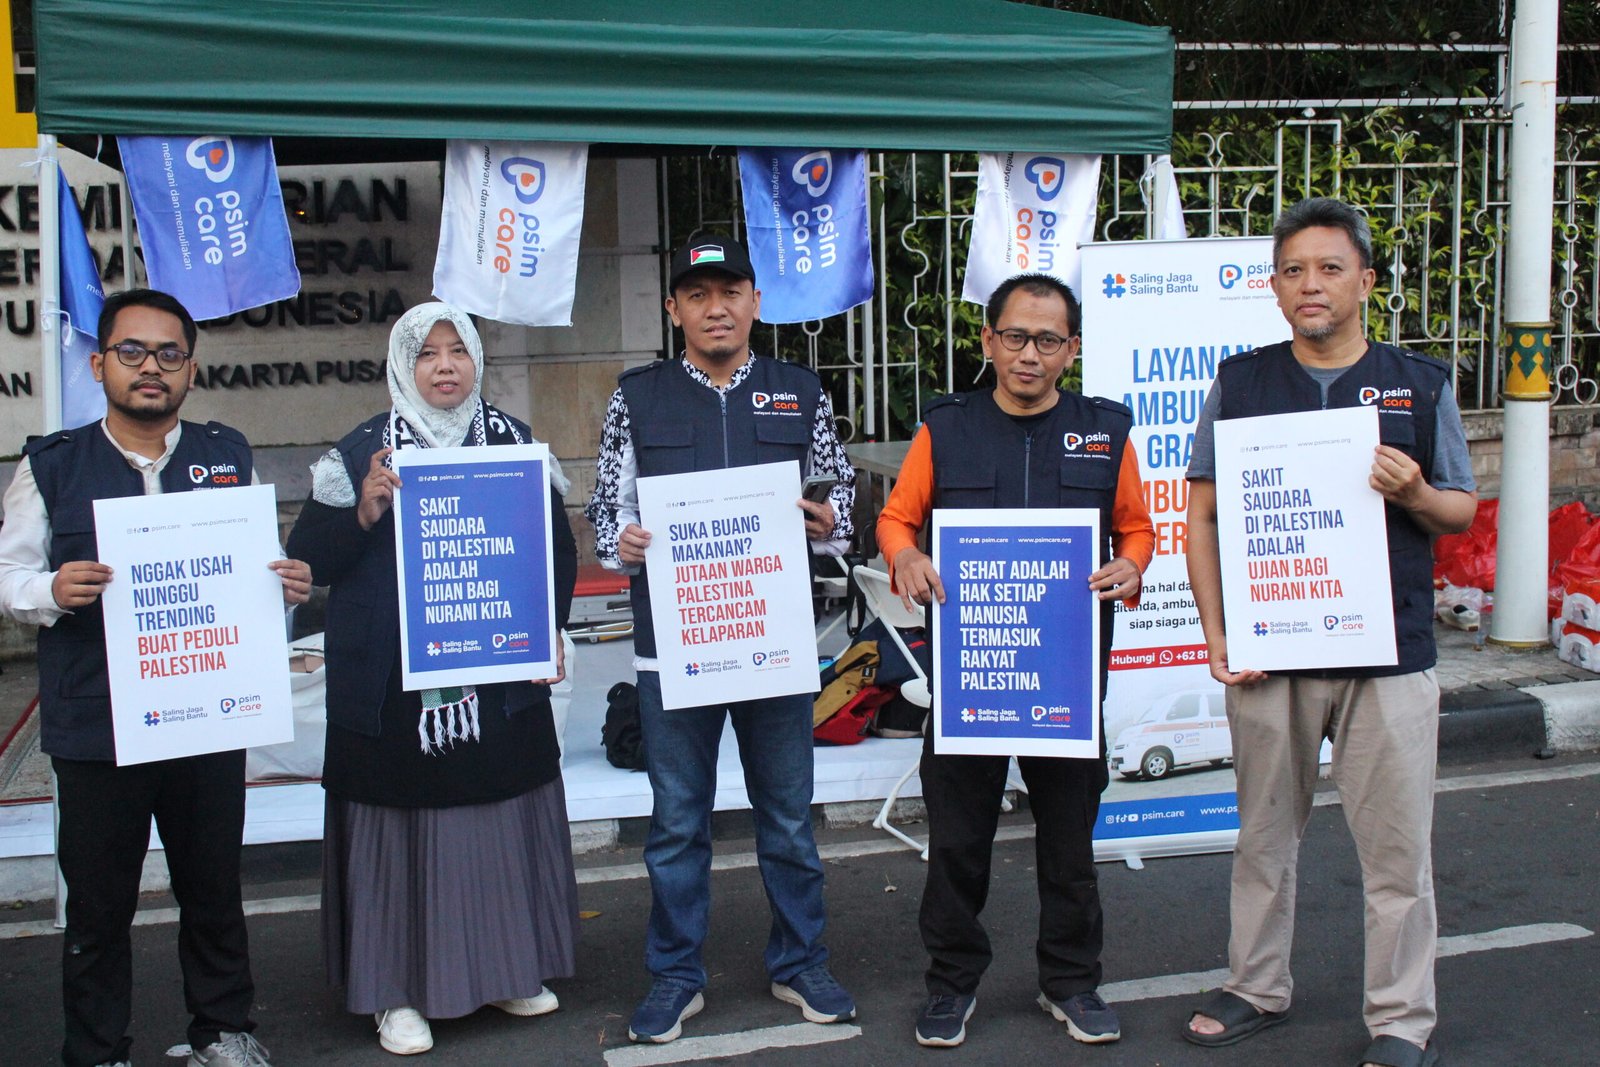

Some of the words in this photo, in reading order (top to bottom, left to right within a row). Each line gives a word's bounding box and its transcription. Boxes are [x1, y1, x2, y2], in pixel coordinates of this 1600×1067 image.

[162, 142, 178, 187] melayani
[170, 189, 180, 208] dan
[481, 145, 491, 188] melayani
[771, 158, 781, 199] melayani
[480, 188, 490, 208] dan
[772, 200, 781, 219] dan
[195, 197, 223, 265] care
[215, 190, 248, 257] psim
[494, 207, 516, 274] care
[518, 212, 545, 277] psim
[792, 210, 812, 274] care
[812, 204, 840, 268] psim
[1016, 208, 1033, 270] care
[1037, 210, 1060, 271] psim
[1130, 273, 1163, 285] Saling
[1166, 273, 1193, 284] Jaga
[1130, 284, 1163, 295] Saling
[1166, 284, 1199, 294] Bantu
[773, 392, 797, 401] psim
[1383, 387, 1411, 399] psim
[1383, 399, 1412, 407] care
[774, 402, 799, 410] care
[1085, 432, 1110, 444] psim
[1086, 444, 1110, 452] care
[211, 464, 236, 475] psim
[213, 475, 238, 484] care
[440, 474, 465, 482] psim.care
[473, 472, 524, 480] www.psimcare.org
[1242, 467, 1284, 489] SAKIT
[419, 496, 461, 517] SAKIT
[1243, 488, 1312, 511] SAUDARA
[420, 517, 486, 538] SAUDARA
[669, 520, 708, 542] SUKA
[712, 515, 761, 538] BUANG
[1245, 515, 1260, 534] DI
[1264, 509, 1344, 533] PALESTINA
[422, 541, 436, 560] DI
[440, 536, 515, 559] PALESTINA
[671, 537, 753, 563] MAKANAN?
[1247, 536, 1305, 557] ADALAH
[131, 559, 187, 584] NGGAK
[190, 555, 233, 579] USAH
[423, 560, 479, 581] ADALAH
[674, 558, 728, 584] JUTAAN
[731, 554, 784, 577] WARGA
[959, 561, 1007, 580] SEHAT
[1010, 561, 1070, 580] ADALAH
[1248, 559, 1290, 580] UJIAN
[1294, 557, 1329, 577] BAGI
[133, 582, 200, 608] NUNGGU
[424, 581, 463, 603] UJIAN
[467, 580, 500, 600] BAGI
[676, 580, 754, 605] PALESTINA
[959, 583, 991, 602] HAK
[994, 583, 1047, 602] SETIAP
[1159, 582, 1176, 593] hal
[1250, 581, 1306, 602] NURANI
[1310, 579, 1343, 599] KITA
[135, 604, 216, 632] TRENDING
[425, 602, 478, 624] NURANI
[481, 600, 513, 620] KITA
[679, 599, 767, 625] TERCANCAM
[960, 605, 1028, 625] MANUSIA
[1341, 613, 1363, 623] psim
[681, 620, 765, 646] KELAPARAN
[1129, 619, 1153, 630] siap
[1156, 617, 1186, 629] siaga
[1342, 622, 1364, 630] care
[137, 632, 179, 656] BUAT
[183, 625, 240, 650] PEDULI
[508, 631, 529, 641] psim
[960, 628, 1041, 647] TERMASUK
[769, 649, 789, 659] psim
[770, 657, 790, 665] care
[960, 650, 1017, 669] RAKYAT
[1111, 653, 1156, 665] Hubungi
[1176, 651, 1196, 661] +62
[1197, 650, 1208, 659] 81
[139, 651, 227, 680] PALESTINA
[722, 664, 742, 672] Bantu
[961, 672, 1041, 691] PALESTINA
[238, 694, 261, 705] psim
[239, 703, 262, 712] care
[162, 709, 185, 717] Saling
[186, 706, 204, 715] Jaga
[162, 715, 185, 723] Saling
[186, 712, 208, 720] Bantu
[977, 708, 999, 716] Saling
[1049, 705, 1070, 715] psim
[1142, 810, 1185, 822] psim.care
